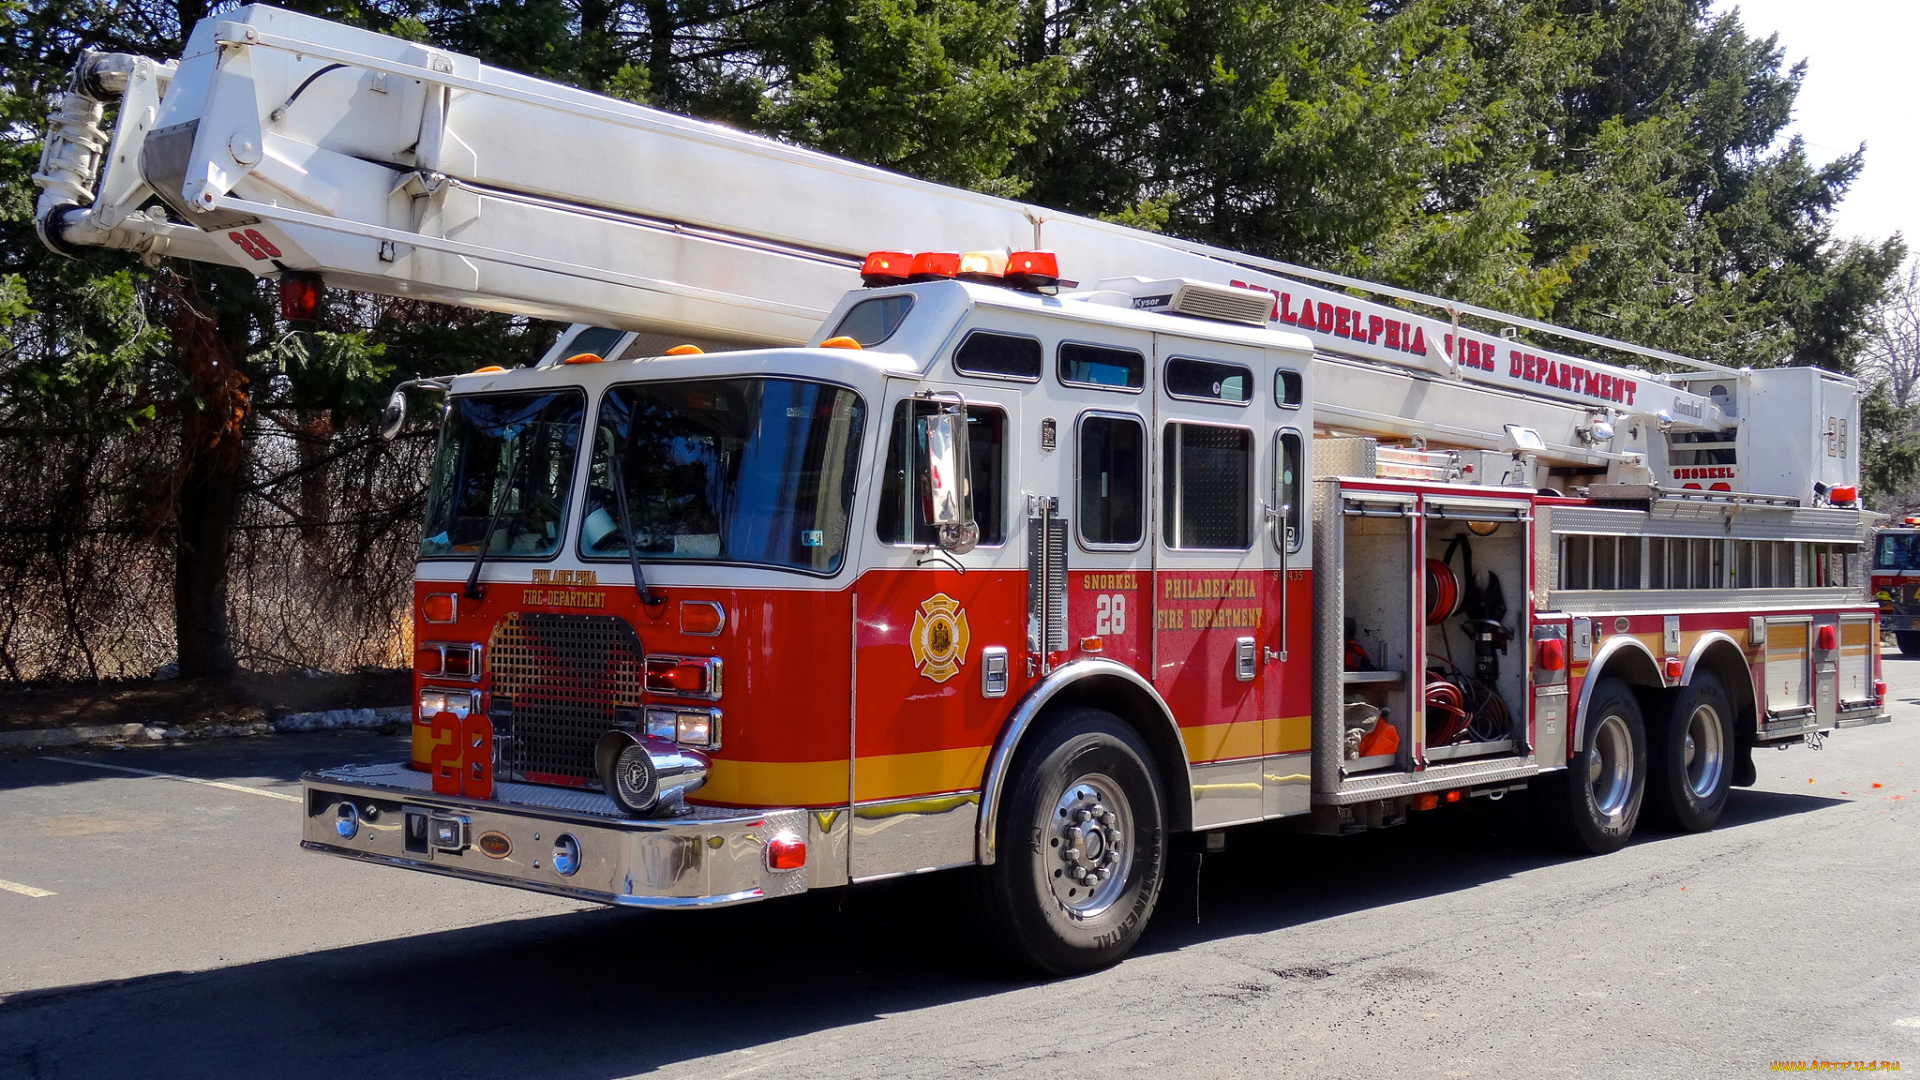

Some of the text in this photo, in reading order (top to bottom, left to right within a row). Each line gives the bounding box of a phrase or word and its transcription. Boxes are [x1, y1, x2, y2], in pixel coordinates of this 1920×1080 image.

[228, 229, 282, 260] 28
[1134, 298, 1160, 308] Kysor
[1230, 279, 1427, 356] ILADELPHIA
[1509, 350, 1637, 406] DEPARTMENT
[1827, 416, 1847, 458] 28
[1673, 467, 1735, 479] SNORKEL
[532, 569, 597, 587] PHILADELPHIA
[1084, 574, 1138, 590] SNORKEL
[1164, 578, 1256, 600] PHILADELPHIA
[522, 589, 606, 609] FIRE DEPARTMENT
[1096, 594, 1126, 635] 28
[1157, 607, 1263, 630] FIRE DEPARTMENT
[1784, 681, 1789, 695] 5
[431, 711, 493, 801] 28
